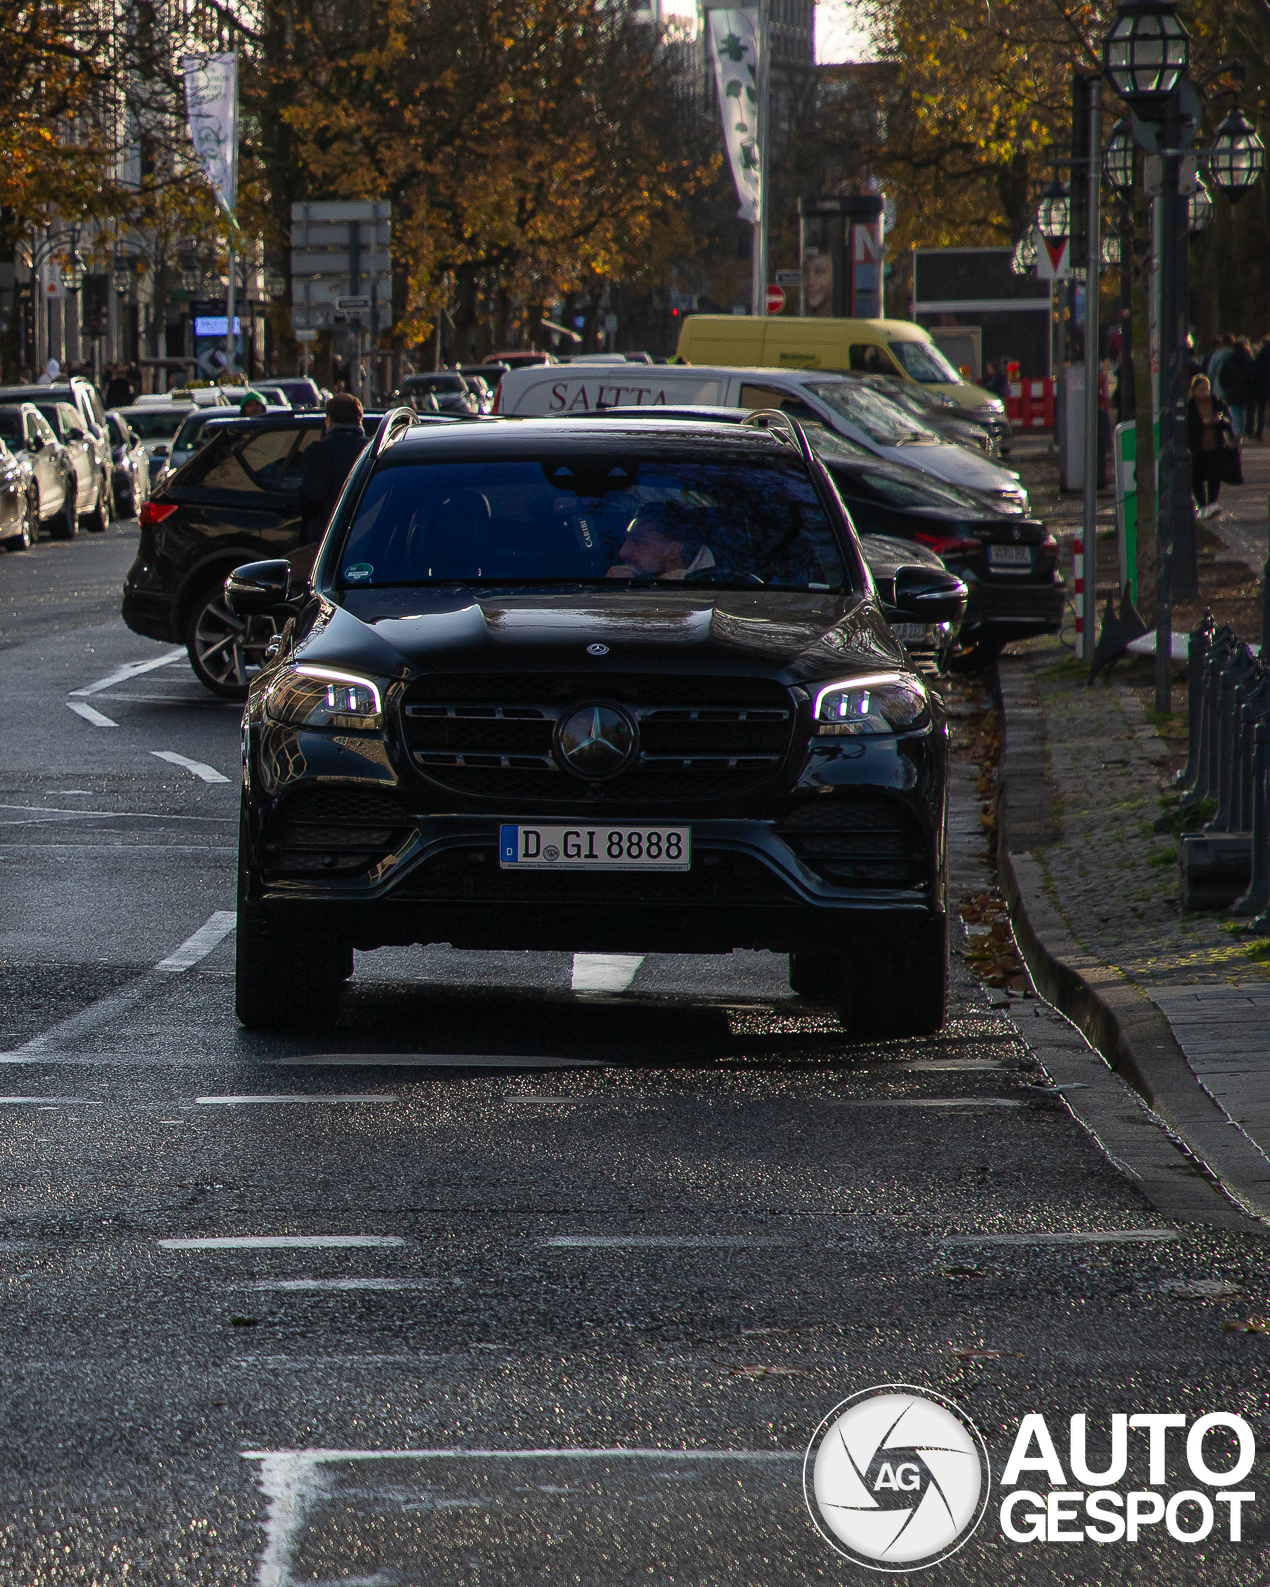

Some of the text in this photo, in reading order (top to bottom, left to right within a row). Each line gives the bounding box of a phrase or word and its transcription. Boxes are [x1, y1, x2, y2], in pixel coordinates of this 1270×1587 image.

[549, 382, 667, 412] SAITTA
[506, 847, 513, 856] D
[522, 830, 683, 860] D GI 8888
